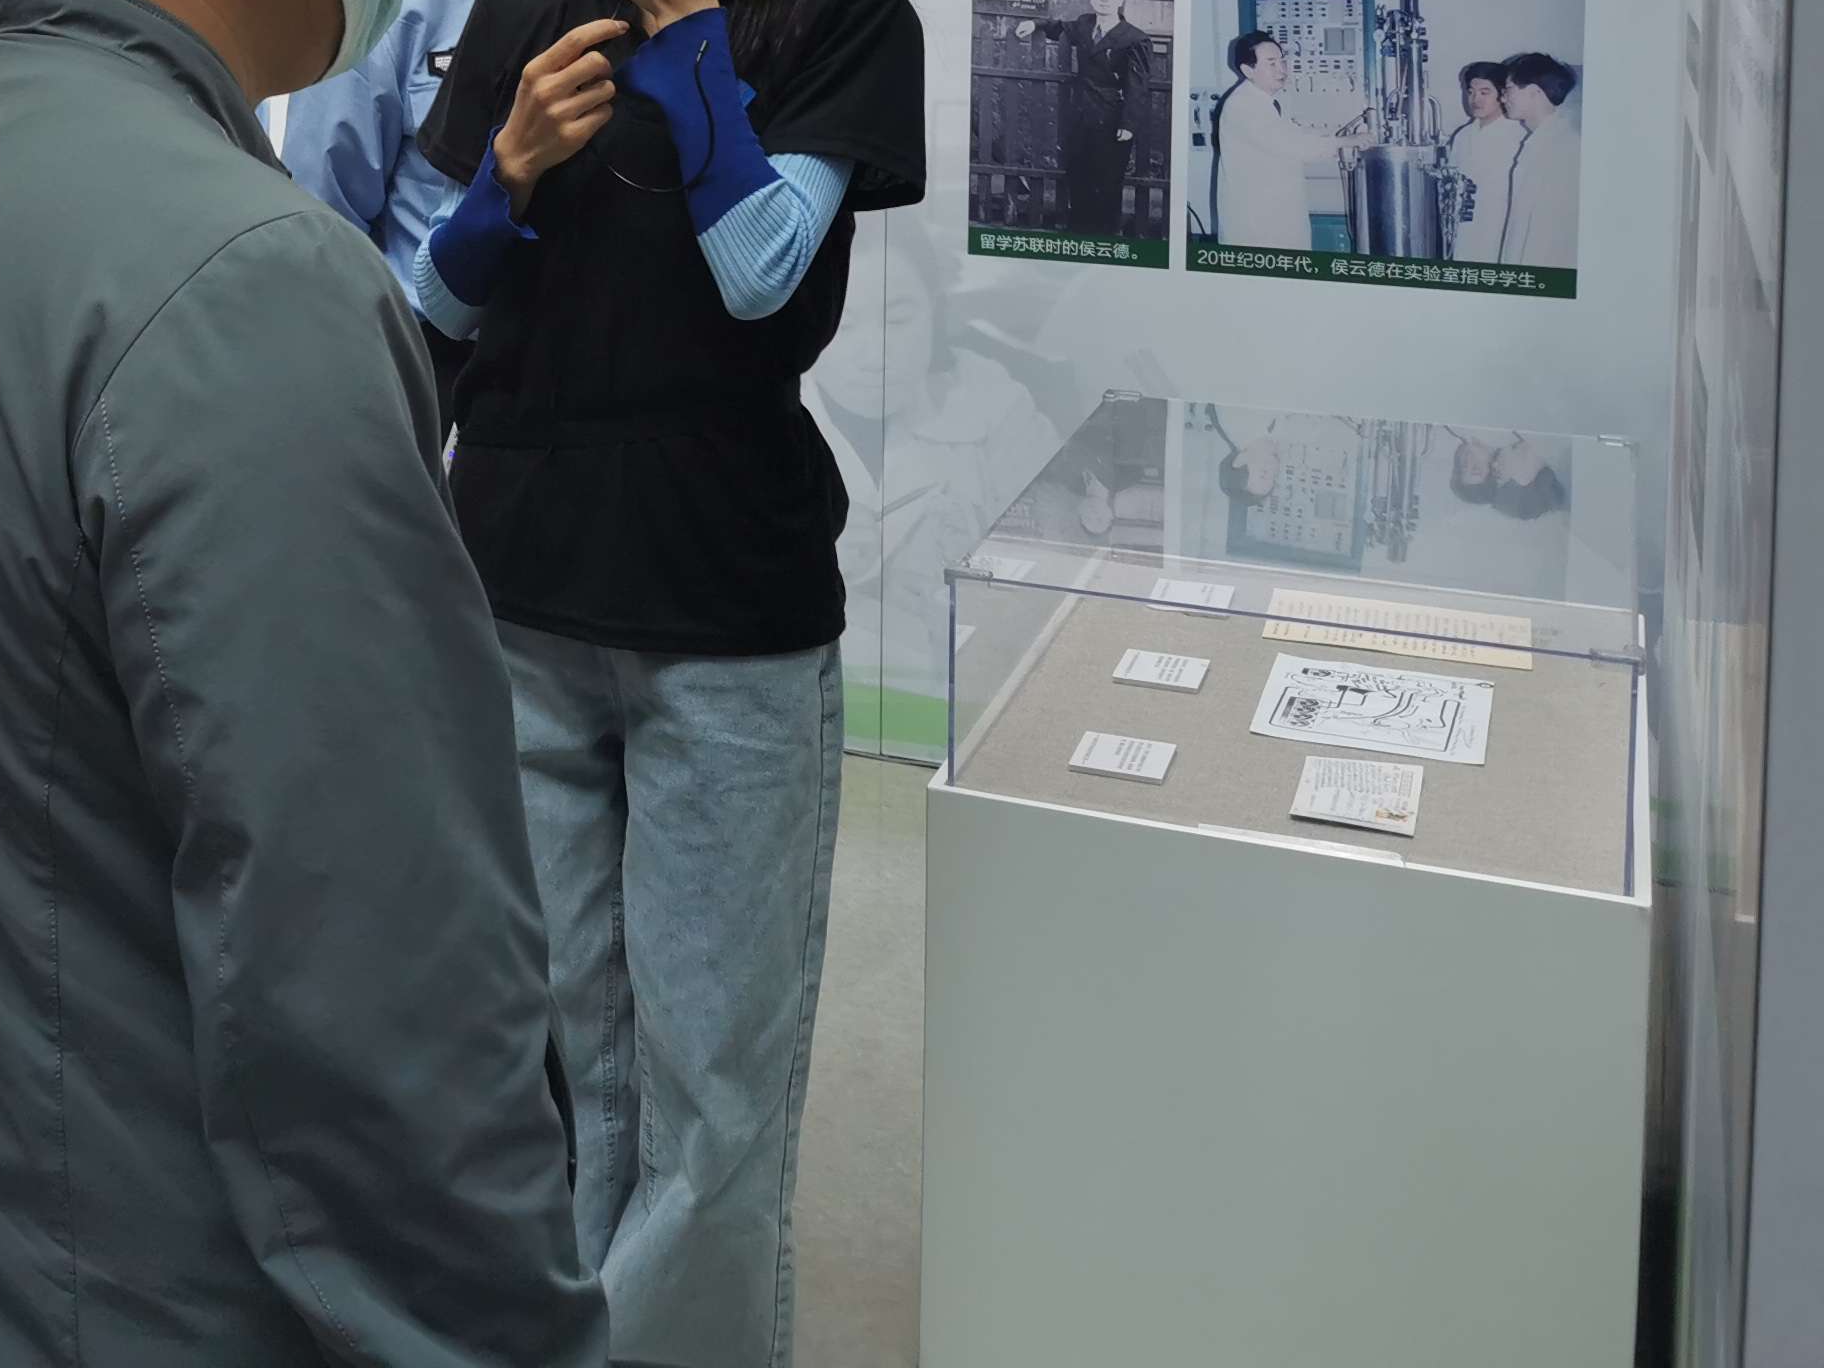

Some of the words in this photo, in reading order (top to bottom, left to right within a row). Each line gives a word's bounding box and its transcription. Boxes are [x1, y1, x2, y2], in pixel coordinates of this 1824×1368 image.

[979, 234, 1140, 260] 留学苏联时的侯云德。
[1197, 250, 1547, 290] 20世纪90年代，侯云德在实验室指导学生。
